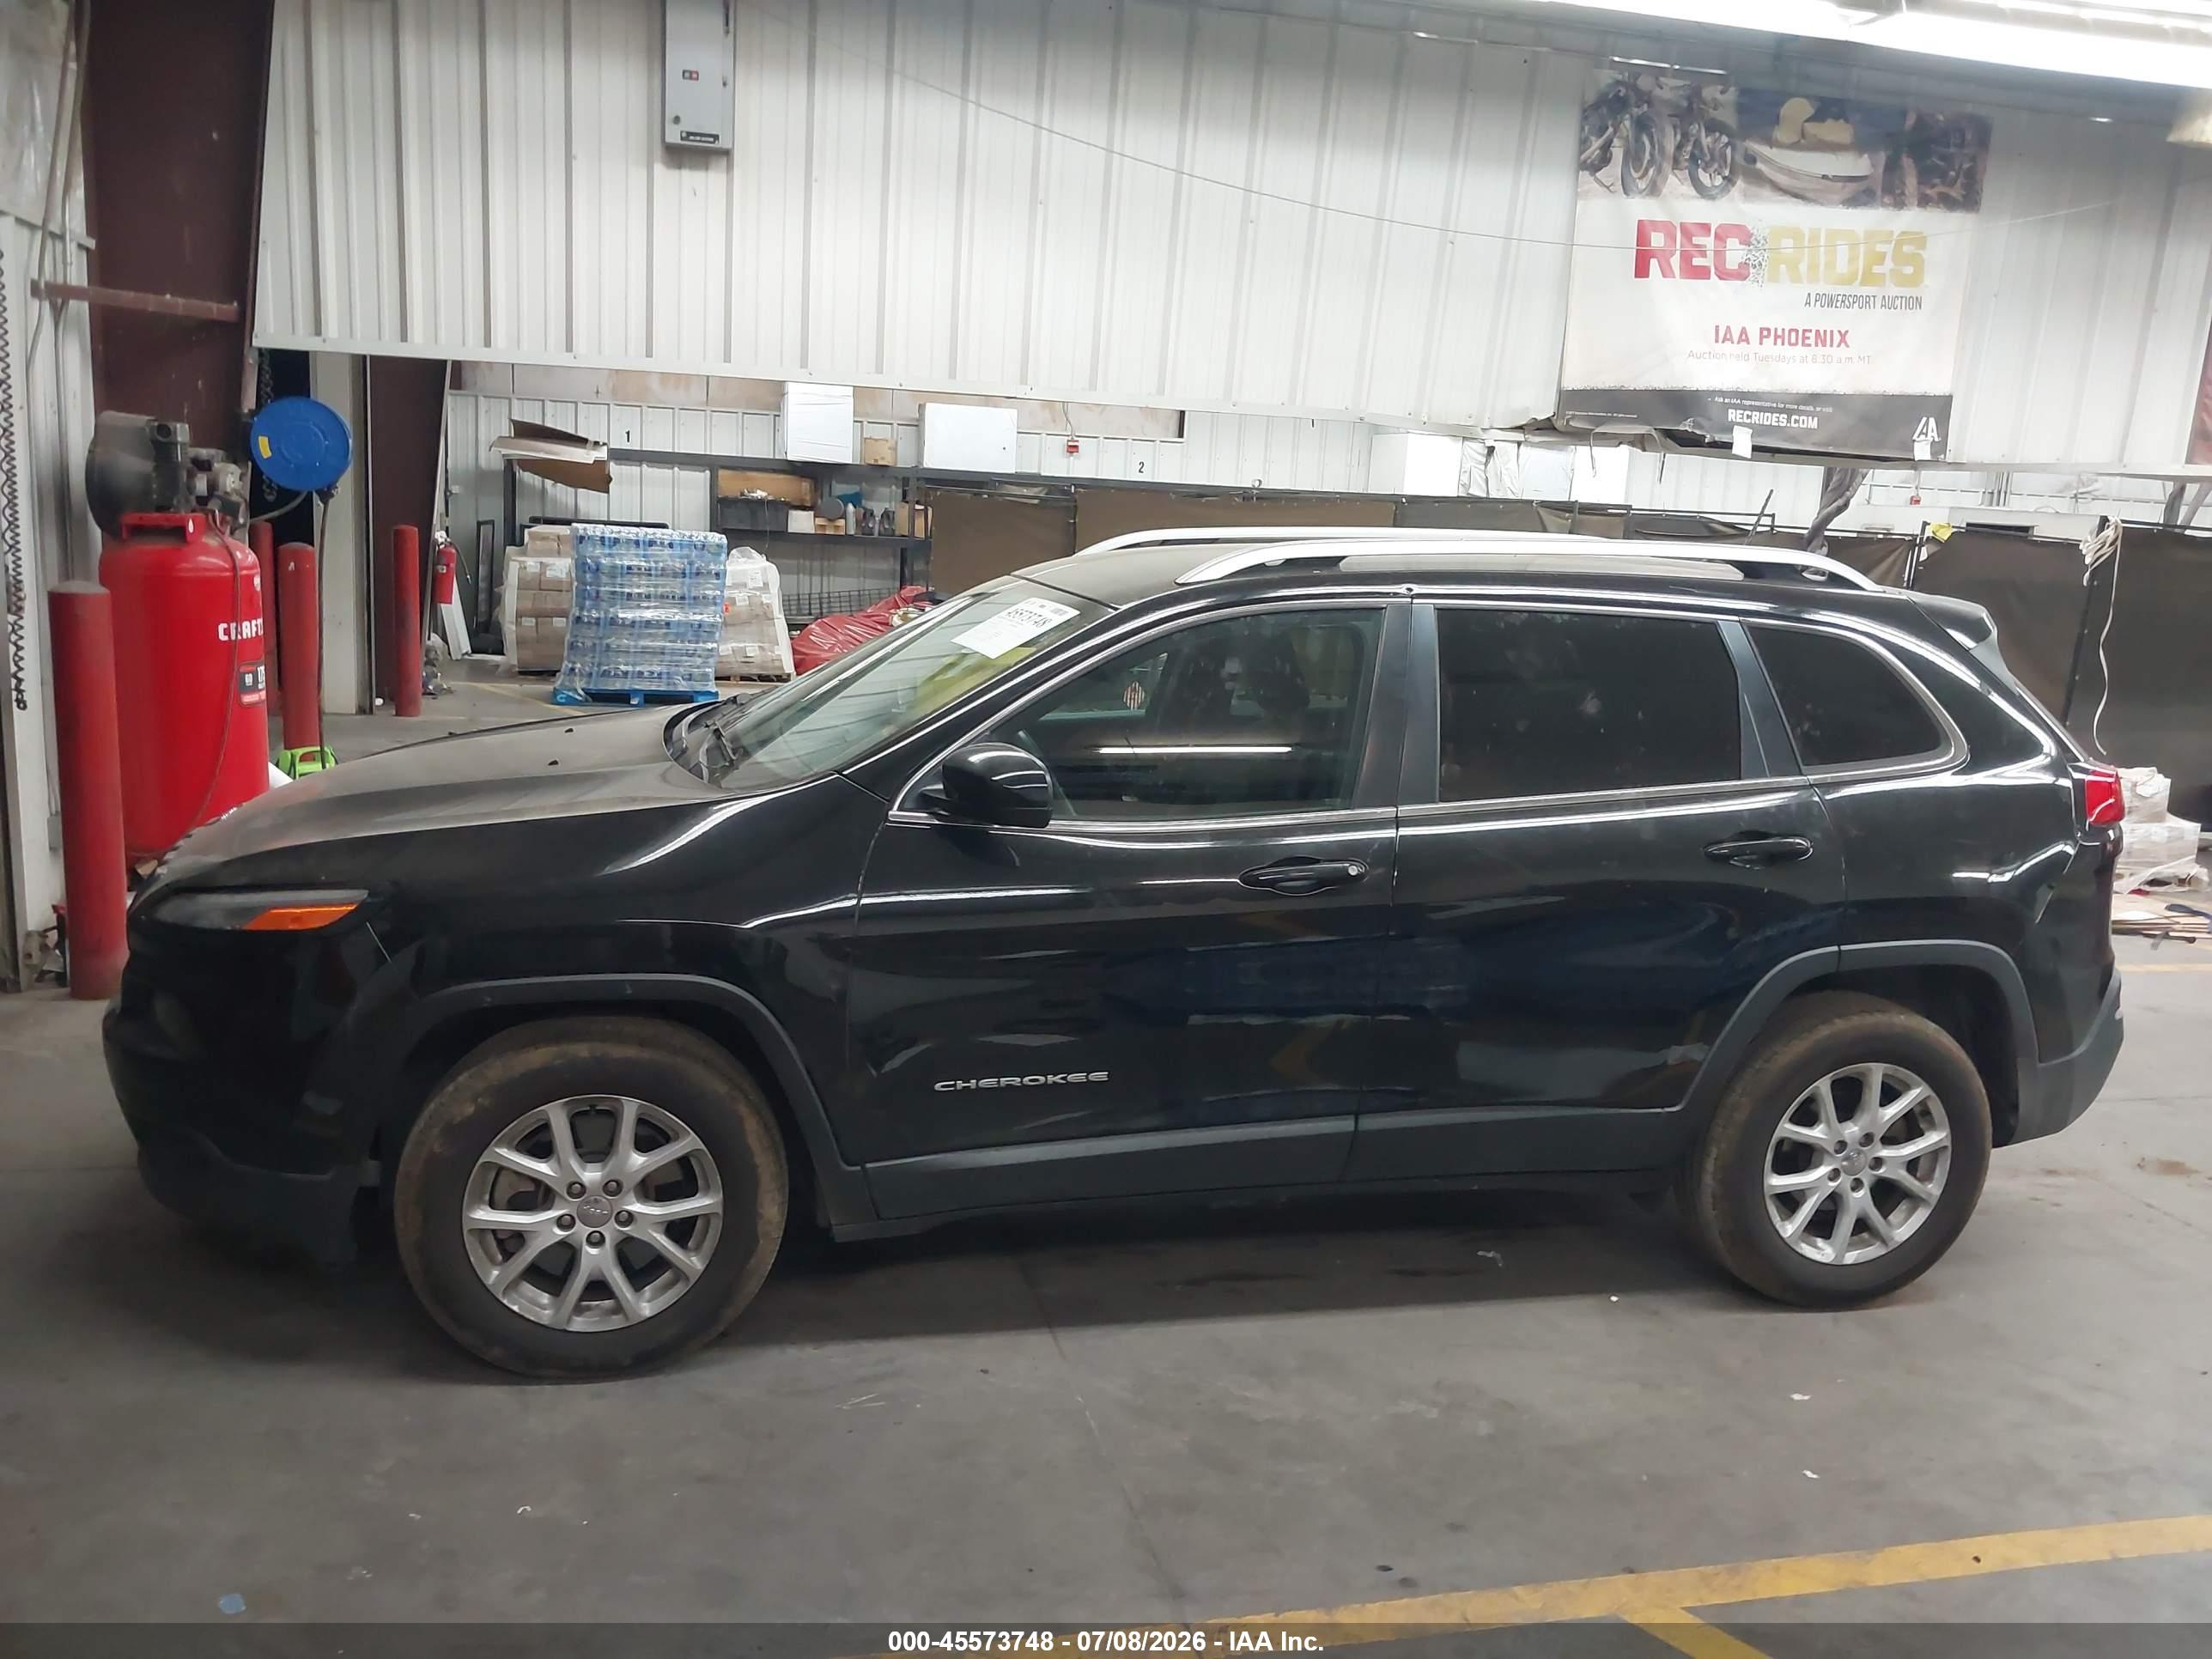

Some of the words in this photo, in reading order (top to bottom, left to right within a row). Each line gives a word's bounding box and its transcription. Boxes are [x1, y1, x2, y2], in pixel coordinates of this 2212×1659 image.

[1634, 219, 1753, 281] REC
[1767, 225, 1927, 288] RIDES
[1804, 292, 1811, 307] A
[1814, 293, 1877, 310] POWERSPORT
[1881, 295, 1923, 311] AUCTION
[1714, 325, 1750, 345] IAA
[1759, 326, 1850, 348] PHOENIX
[1687, 349, 1726, 360] Auction
[1753, 352, 1796, 365] Tuesdays
[1799, 353, 1808, 364] at
[1728, 408, 1819, 429] RECRIDES.COM
[625, 429, 630, 443] 1
[1138, 461, 1145, 474] 2
[933, 1071, 1109, 1091] CHEROKEE
